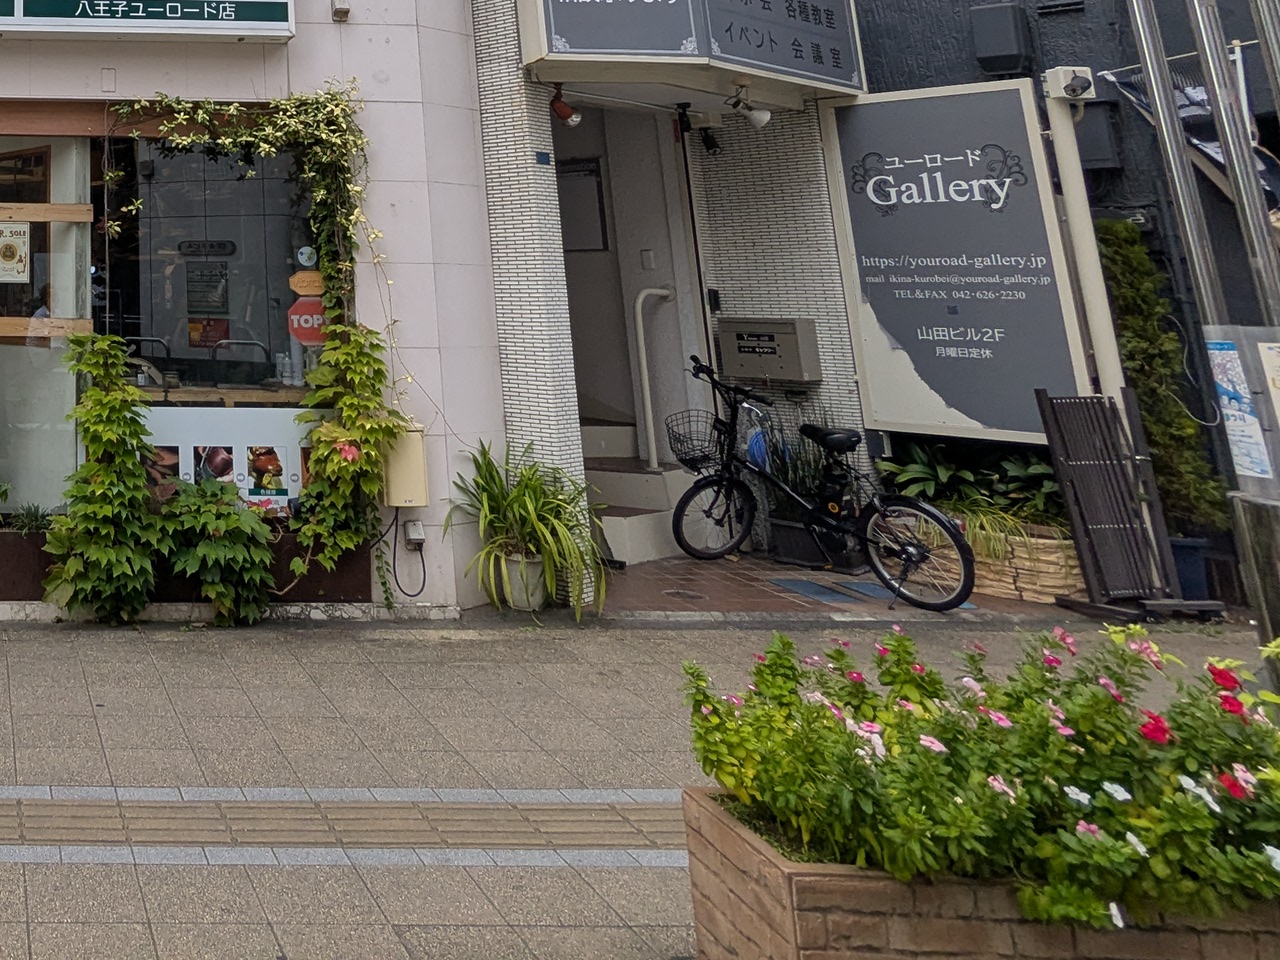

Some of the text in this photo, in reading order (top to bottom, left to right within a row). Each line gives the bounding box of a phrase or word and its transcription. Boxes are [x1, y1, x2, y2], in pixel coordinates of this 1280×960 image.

[74, 0, 236, 20] 八王子ユーロード店
[723, 21, 779, 54] イベント
[883, 149, 983, 170] ユーロード
[865, 171, 1013, 210] Gallery
[8, 230, 27, 238] SOLE
[861, 253, 1047, 270] https://youroad-gallery.jp
[865, 273, 885, 283] mail
[893, 289, 948, 300] TEL&FAX
[917, 325, 1007, 342] 山田ビル2F
[935, 346, 994, 359] 月曜日定休
